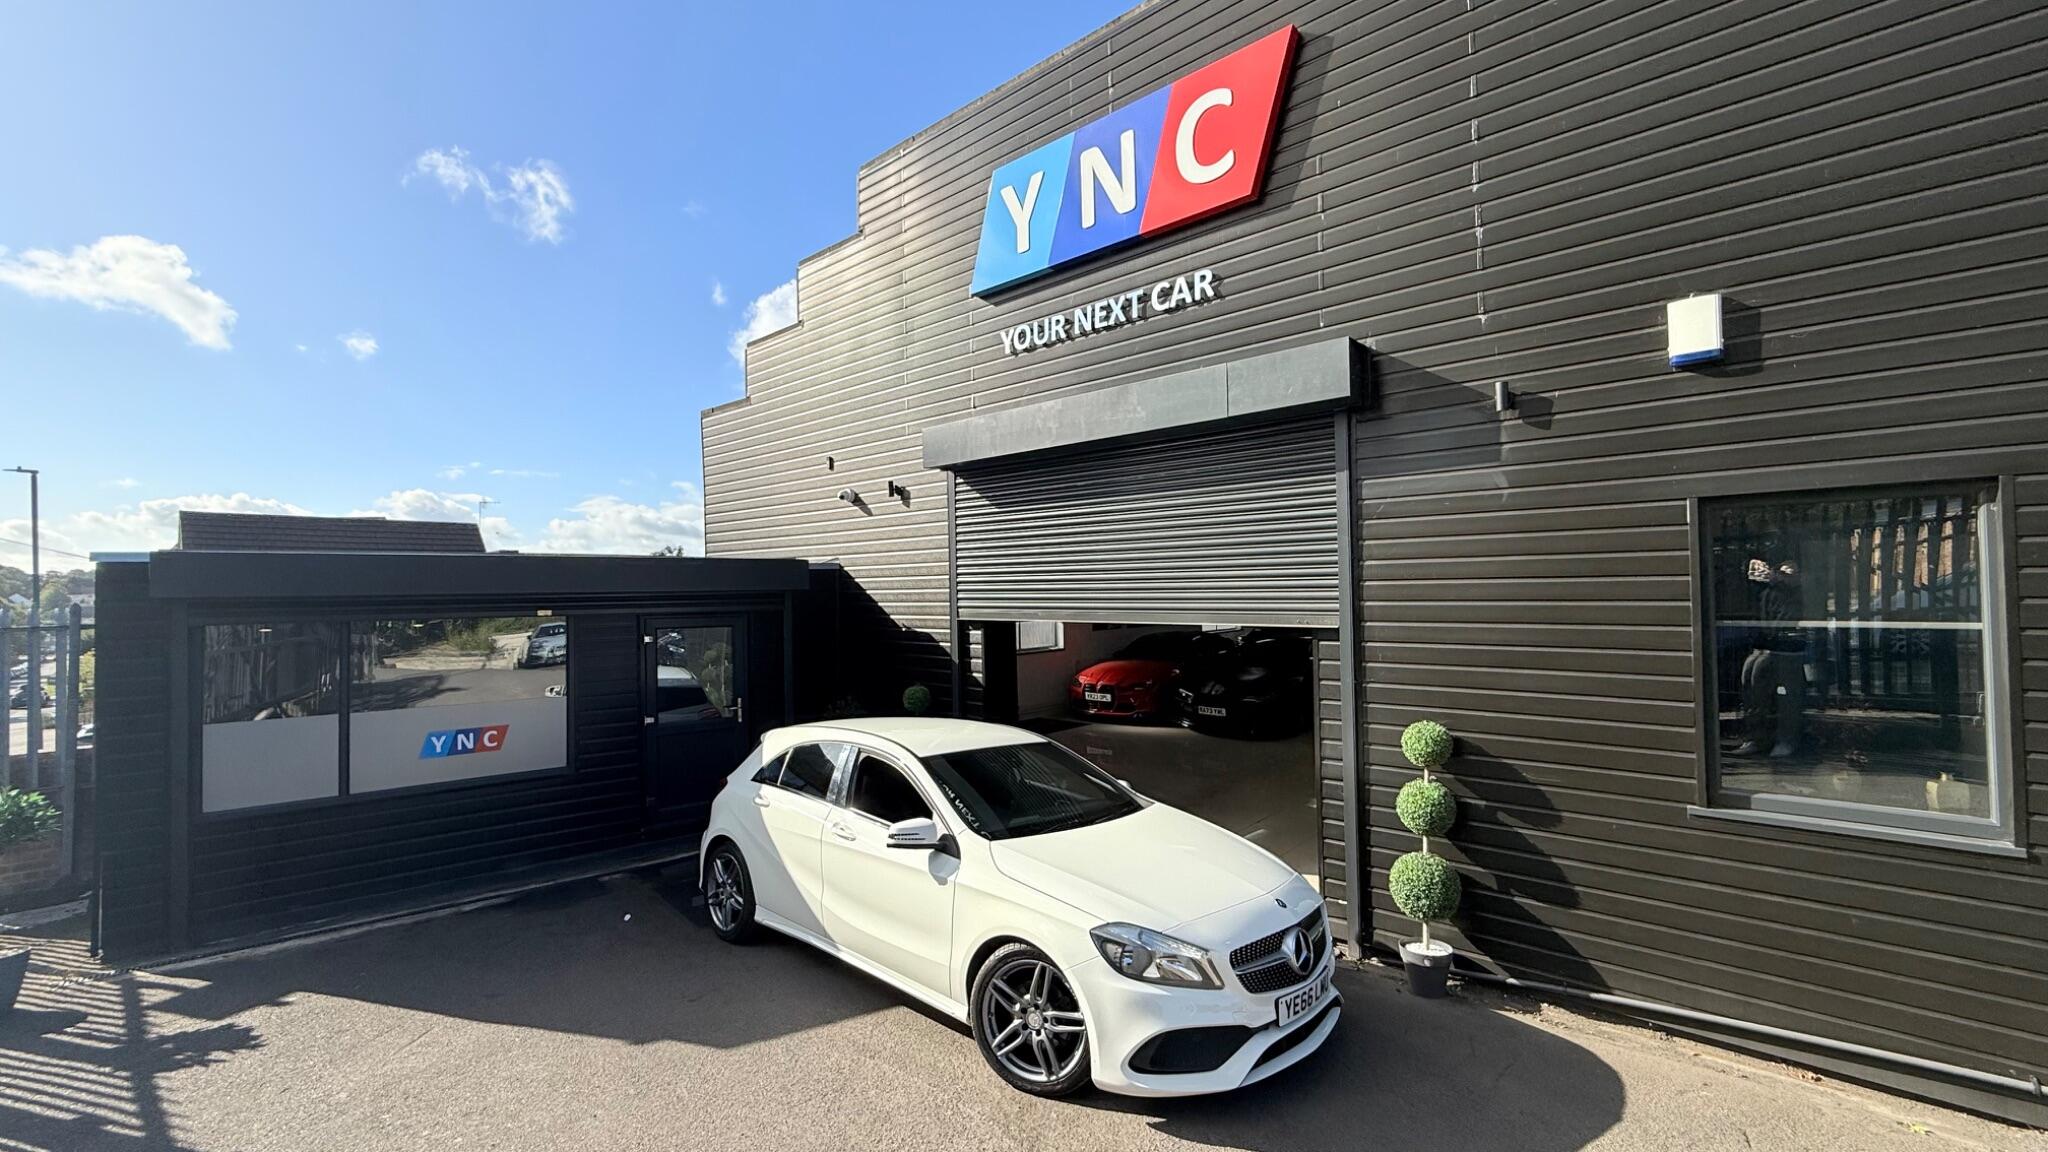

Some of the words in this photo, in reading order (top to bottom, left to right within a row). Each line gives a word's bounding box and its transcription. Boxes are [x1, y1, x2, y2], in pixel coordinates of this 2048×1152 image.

[1000, 87, 1236, 254] YNC
[1000, 313, 1067, 355] YOUR
[1073, 288, 1144, 335] NEXT
[1150, 268, 1216, 312] CAR
[430, 730, 498, 753] YNC
[1284, 987, 1313, 1019] YE66
